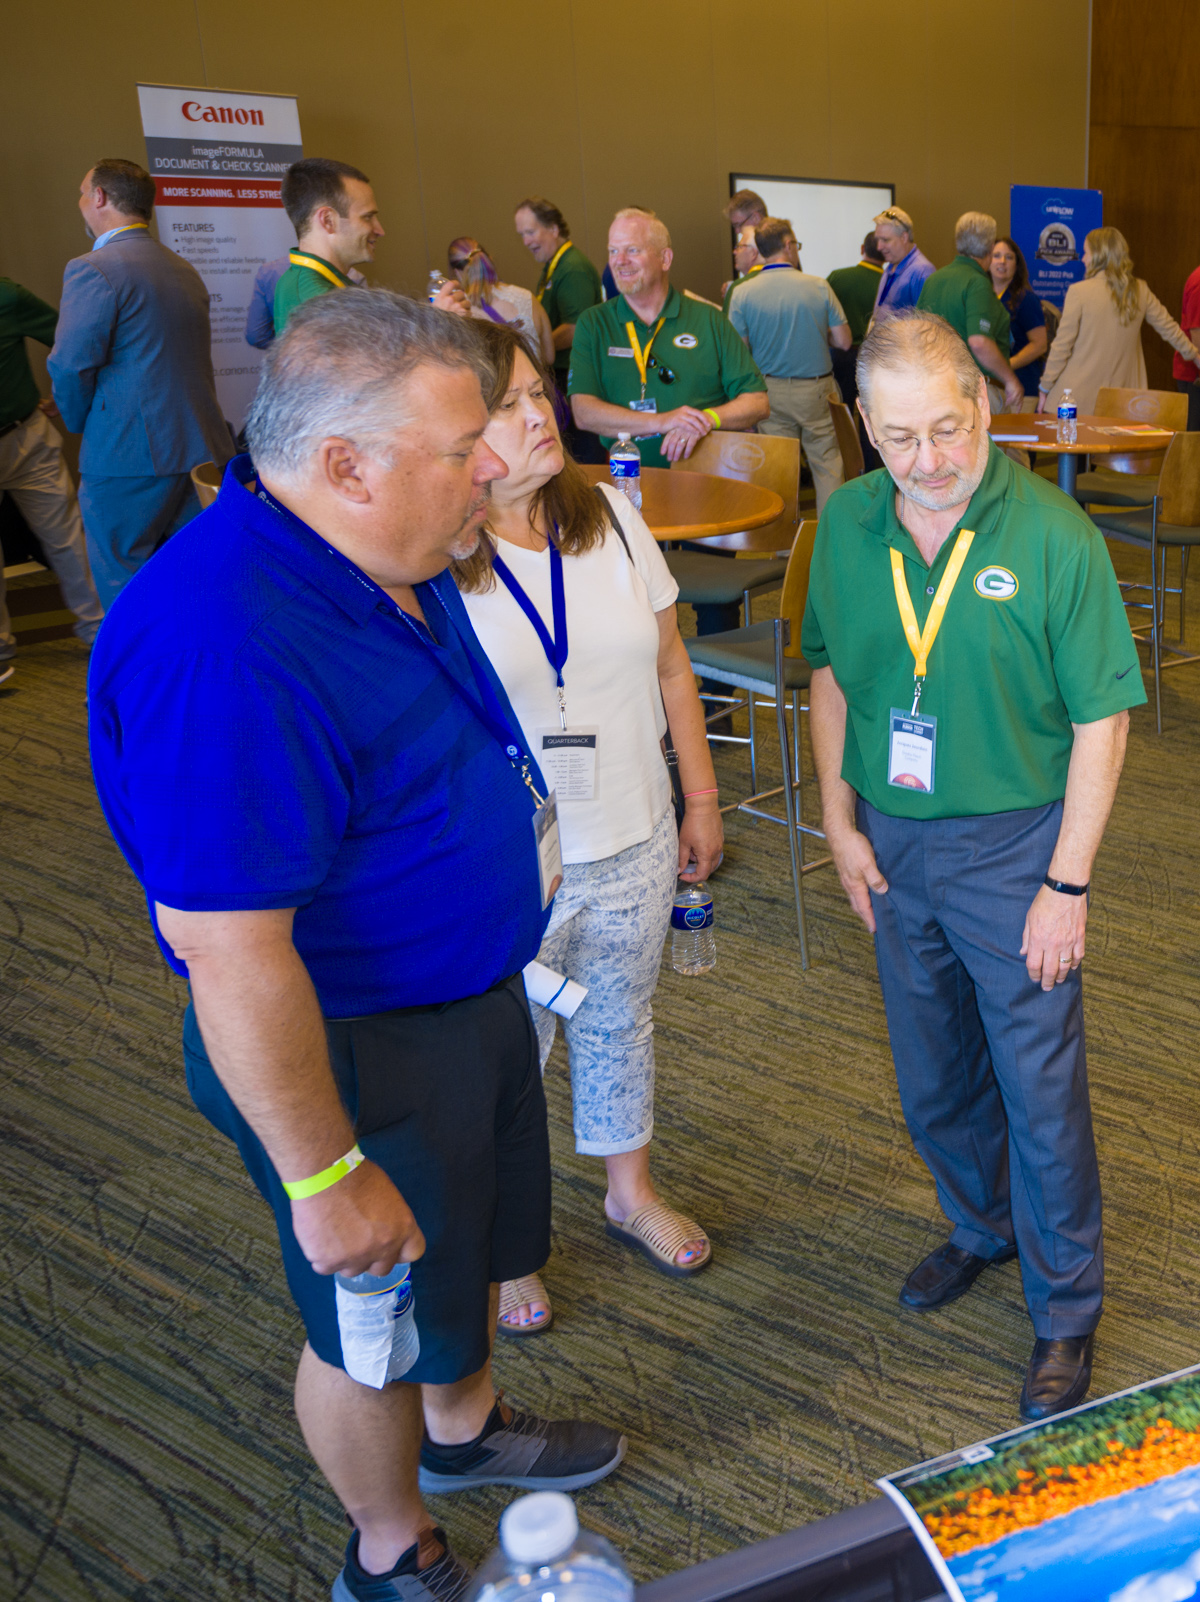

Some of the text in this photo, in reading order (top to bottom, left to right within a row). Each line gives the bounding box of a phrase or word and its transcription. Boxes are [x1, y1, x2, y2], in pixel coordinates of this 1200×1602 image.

[181, 101, 265, 126] Canon
[192, 146, 264, 159] imageFORMULA
[155, 157, 210, 170] DOCUMENT
[211, 160, 220, 171] &
[221, 161, 252, 172] CHECK
[163, 187, 189, 197] MORE
[191, 188, 235, 198] SCANNING.
[237, 190, 258, 199] LESS
[172, 223, 215, 233] FEATURES
[181, 236, 237, 245] High image quality
[547, 737, 589, 746] QUARTERBACK
